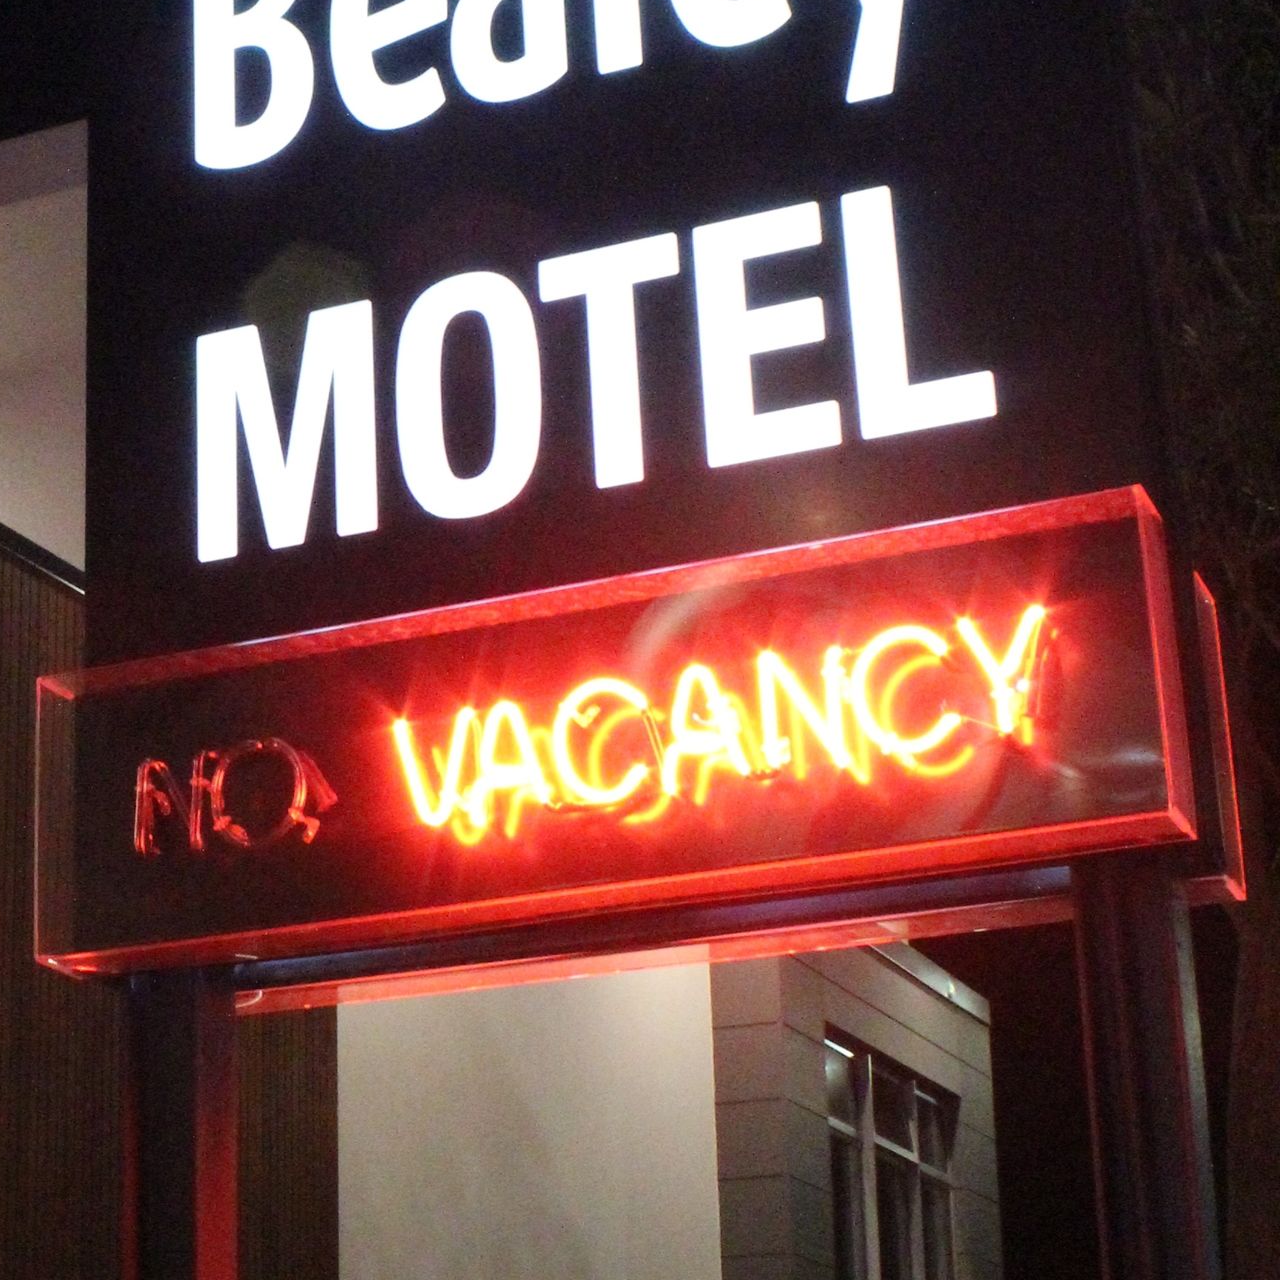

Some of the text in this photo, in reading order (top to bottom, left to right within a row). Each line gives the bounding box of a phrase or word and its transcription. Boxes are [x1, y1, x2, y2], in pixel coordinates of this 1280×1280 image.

[195, 185, 998, 564] MOTEL
[134, 602, 1046, 855] NO VACANCY
